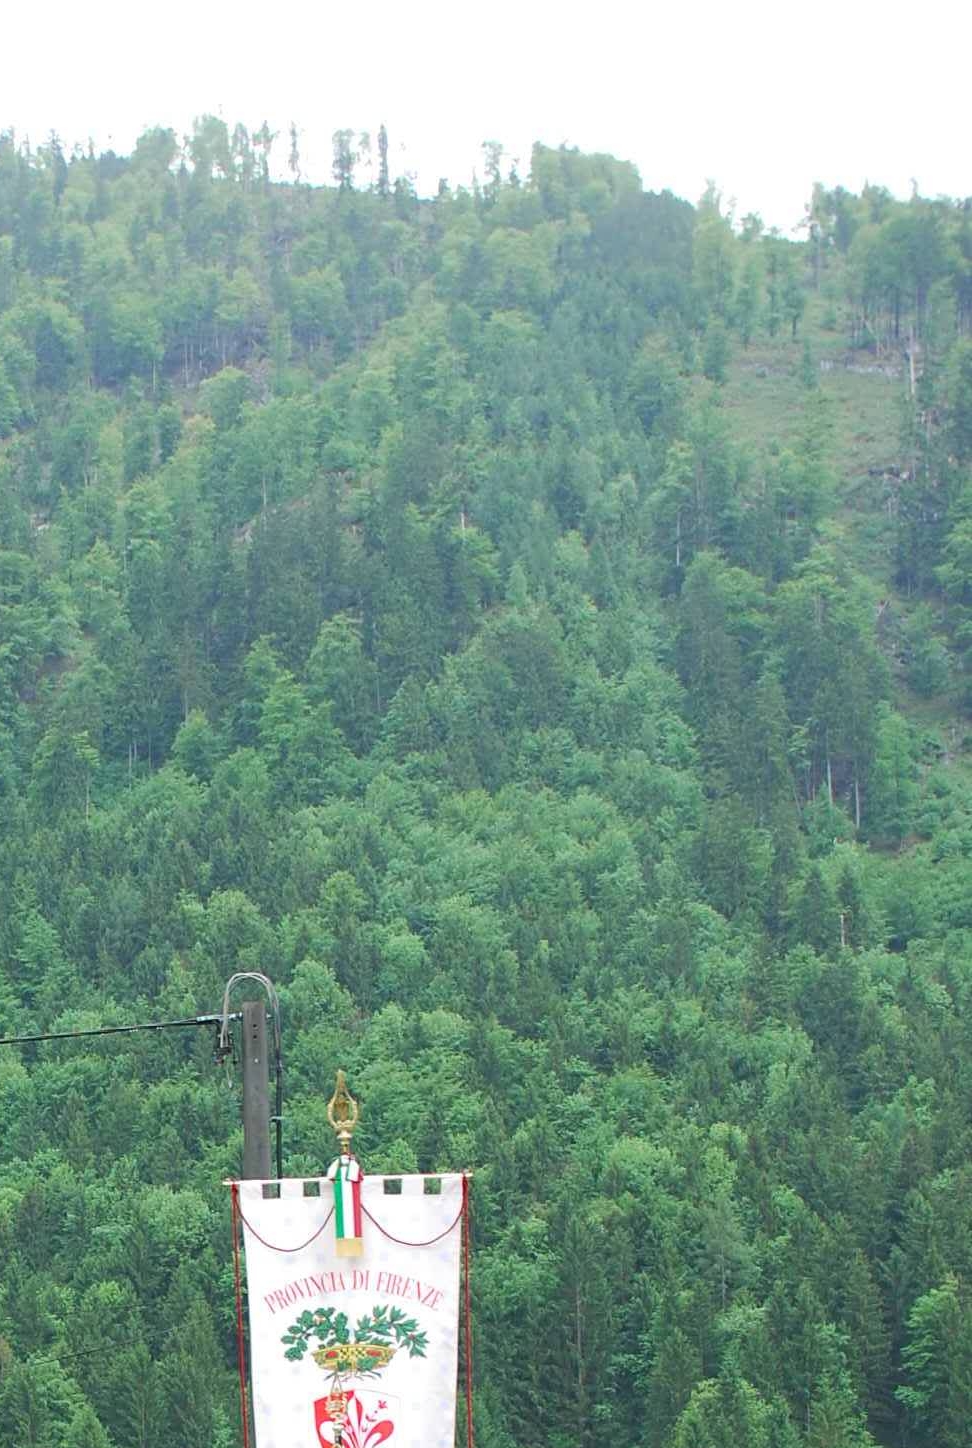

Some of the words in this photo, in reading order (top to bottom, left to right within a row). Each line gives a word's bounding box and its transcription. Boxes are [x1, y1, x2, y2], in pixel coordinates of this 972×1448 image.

[263, 1271, 346, 1314] PROVINCIA
[353, 1269, 370, 1291] DI
[376, 1271, 445, 1311] FIRENZE
